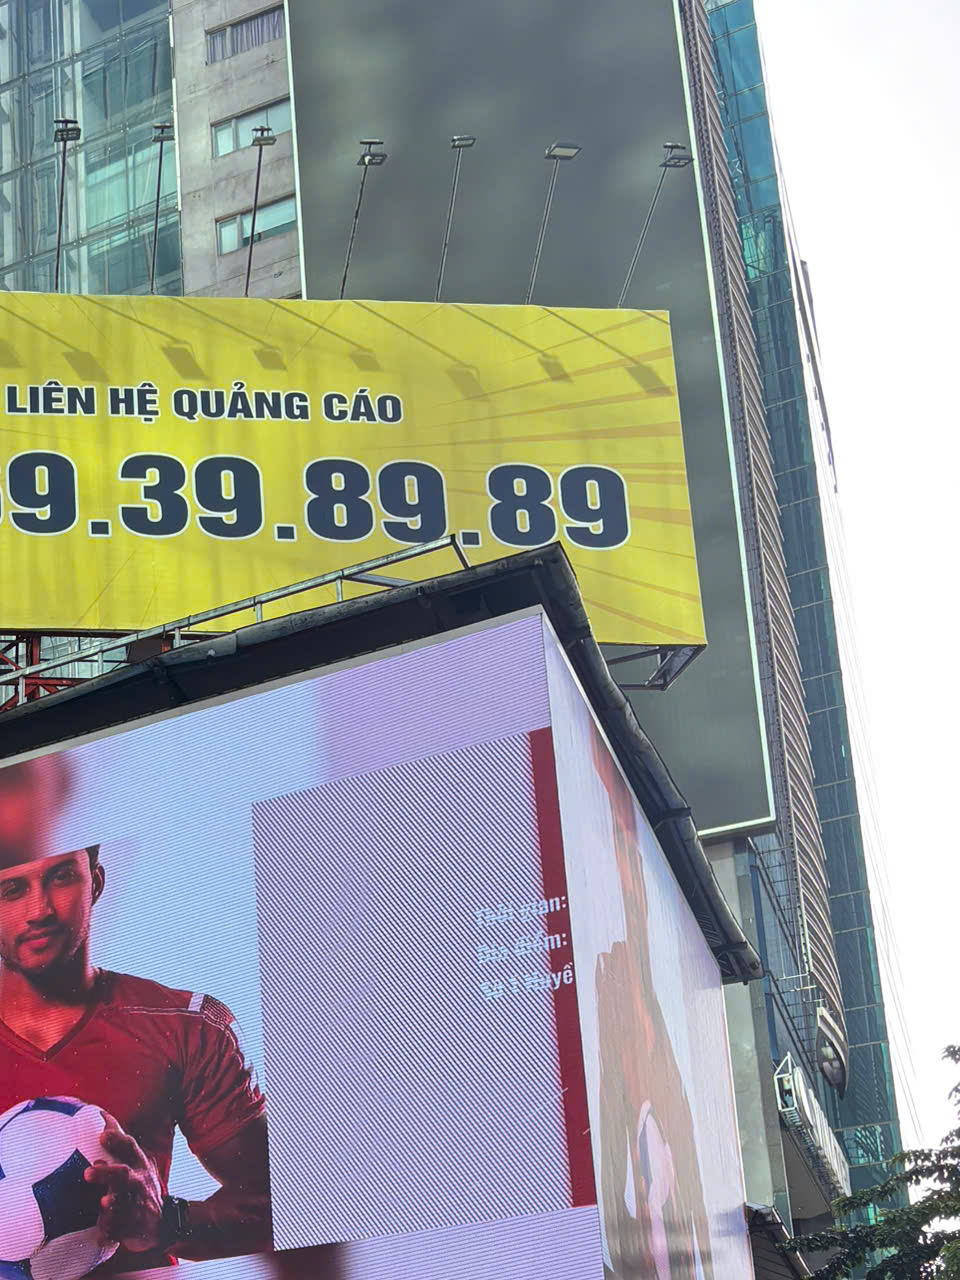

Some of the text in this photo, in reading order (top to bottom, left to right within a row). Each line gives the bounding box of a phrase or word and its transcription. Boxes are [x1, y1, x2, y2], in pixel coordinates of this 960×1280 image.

[5, 380, 403, 424] LIÊN HỆ QUẢNG CÁO
